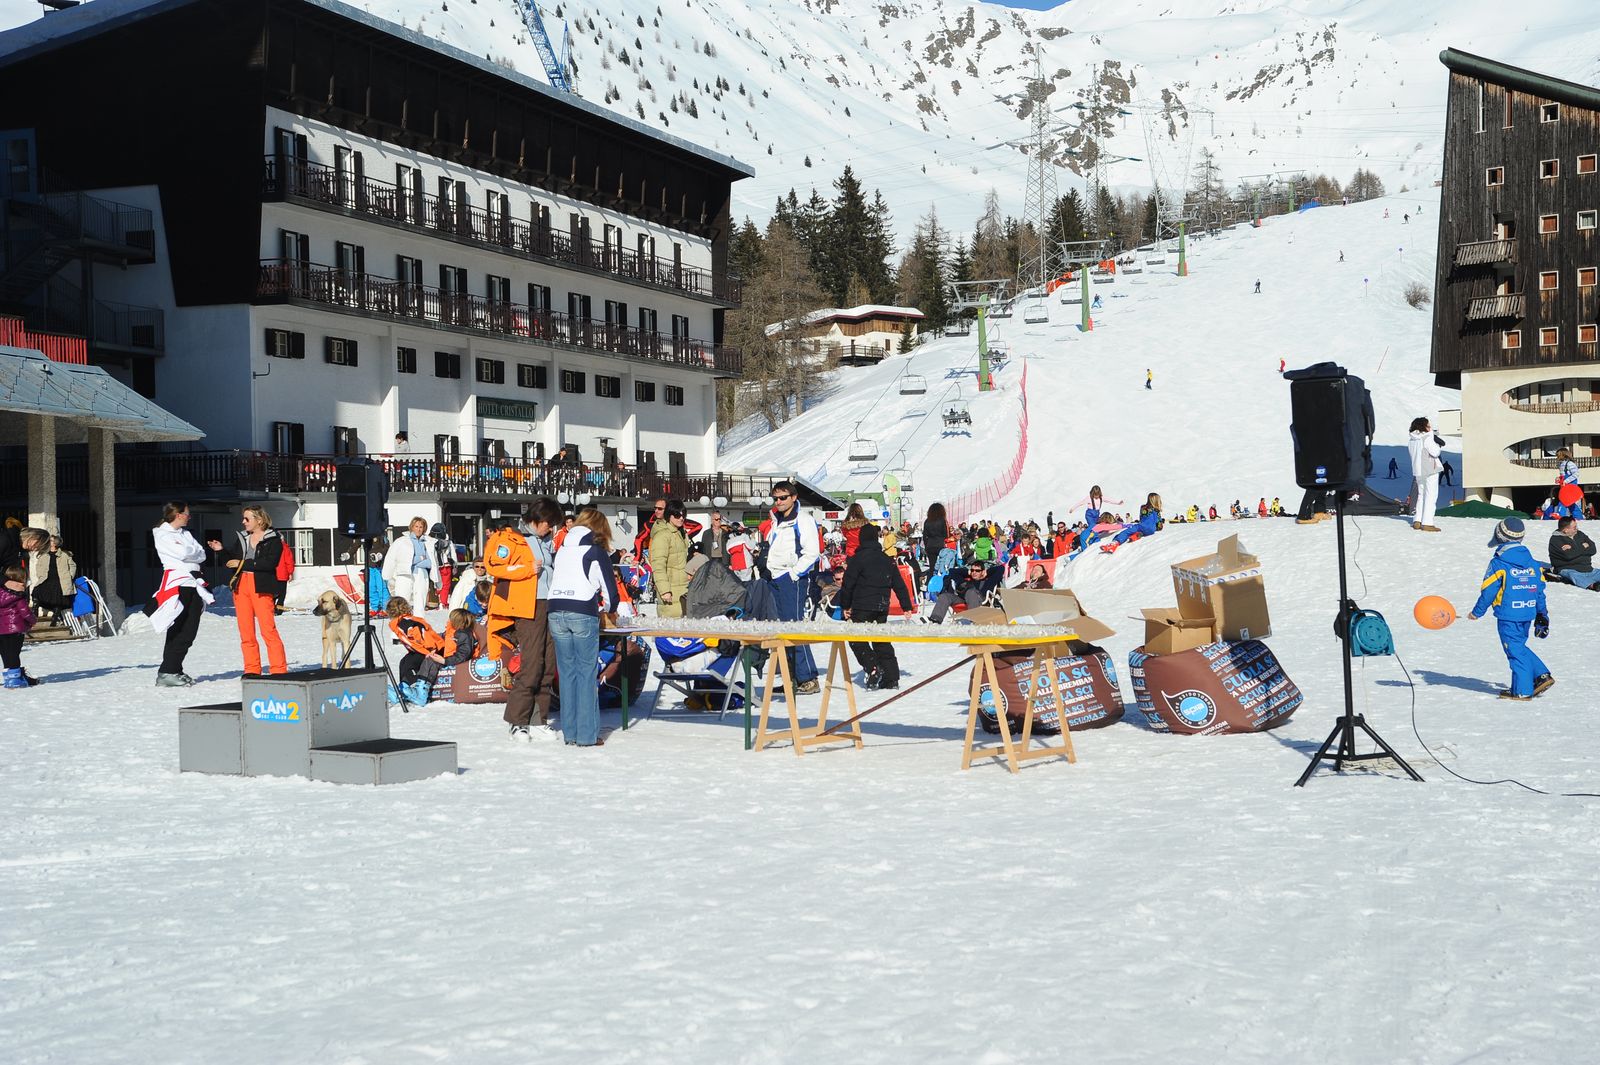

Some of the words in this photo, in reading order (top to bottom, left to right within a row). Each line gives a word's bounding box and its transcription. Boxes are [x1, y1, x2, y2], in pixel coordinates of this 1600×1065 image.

[478, 401, 499, 416] HOTEL
[500, 404, 533, 418] CRISTALLO
[1223, 661, 1265, 692] CUOLA
[1075, 685, 1093, 697] SCI
[1237, 678, 1260, 693] VALLE
[1238, 680, 1277, 705] SCUOLA
